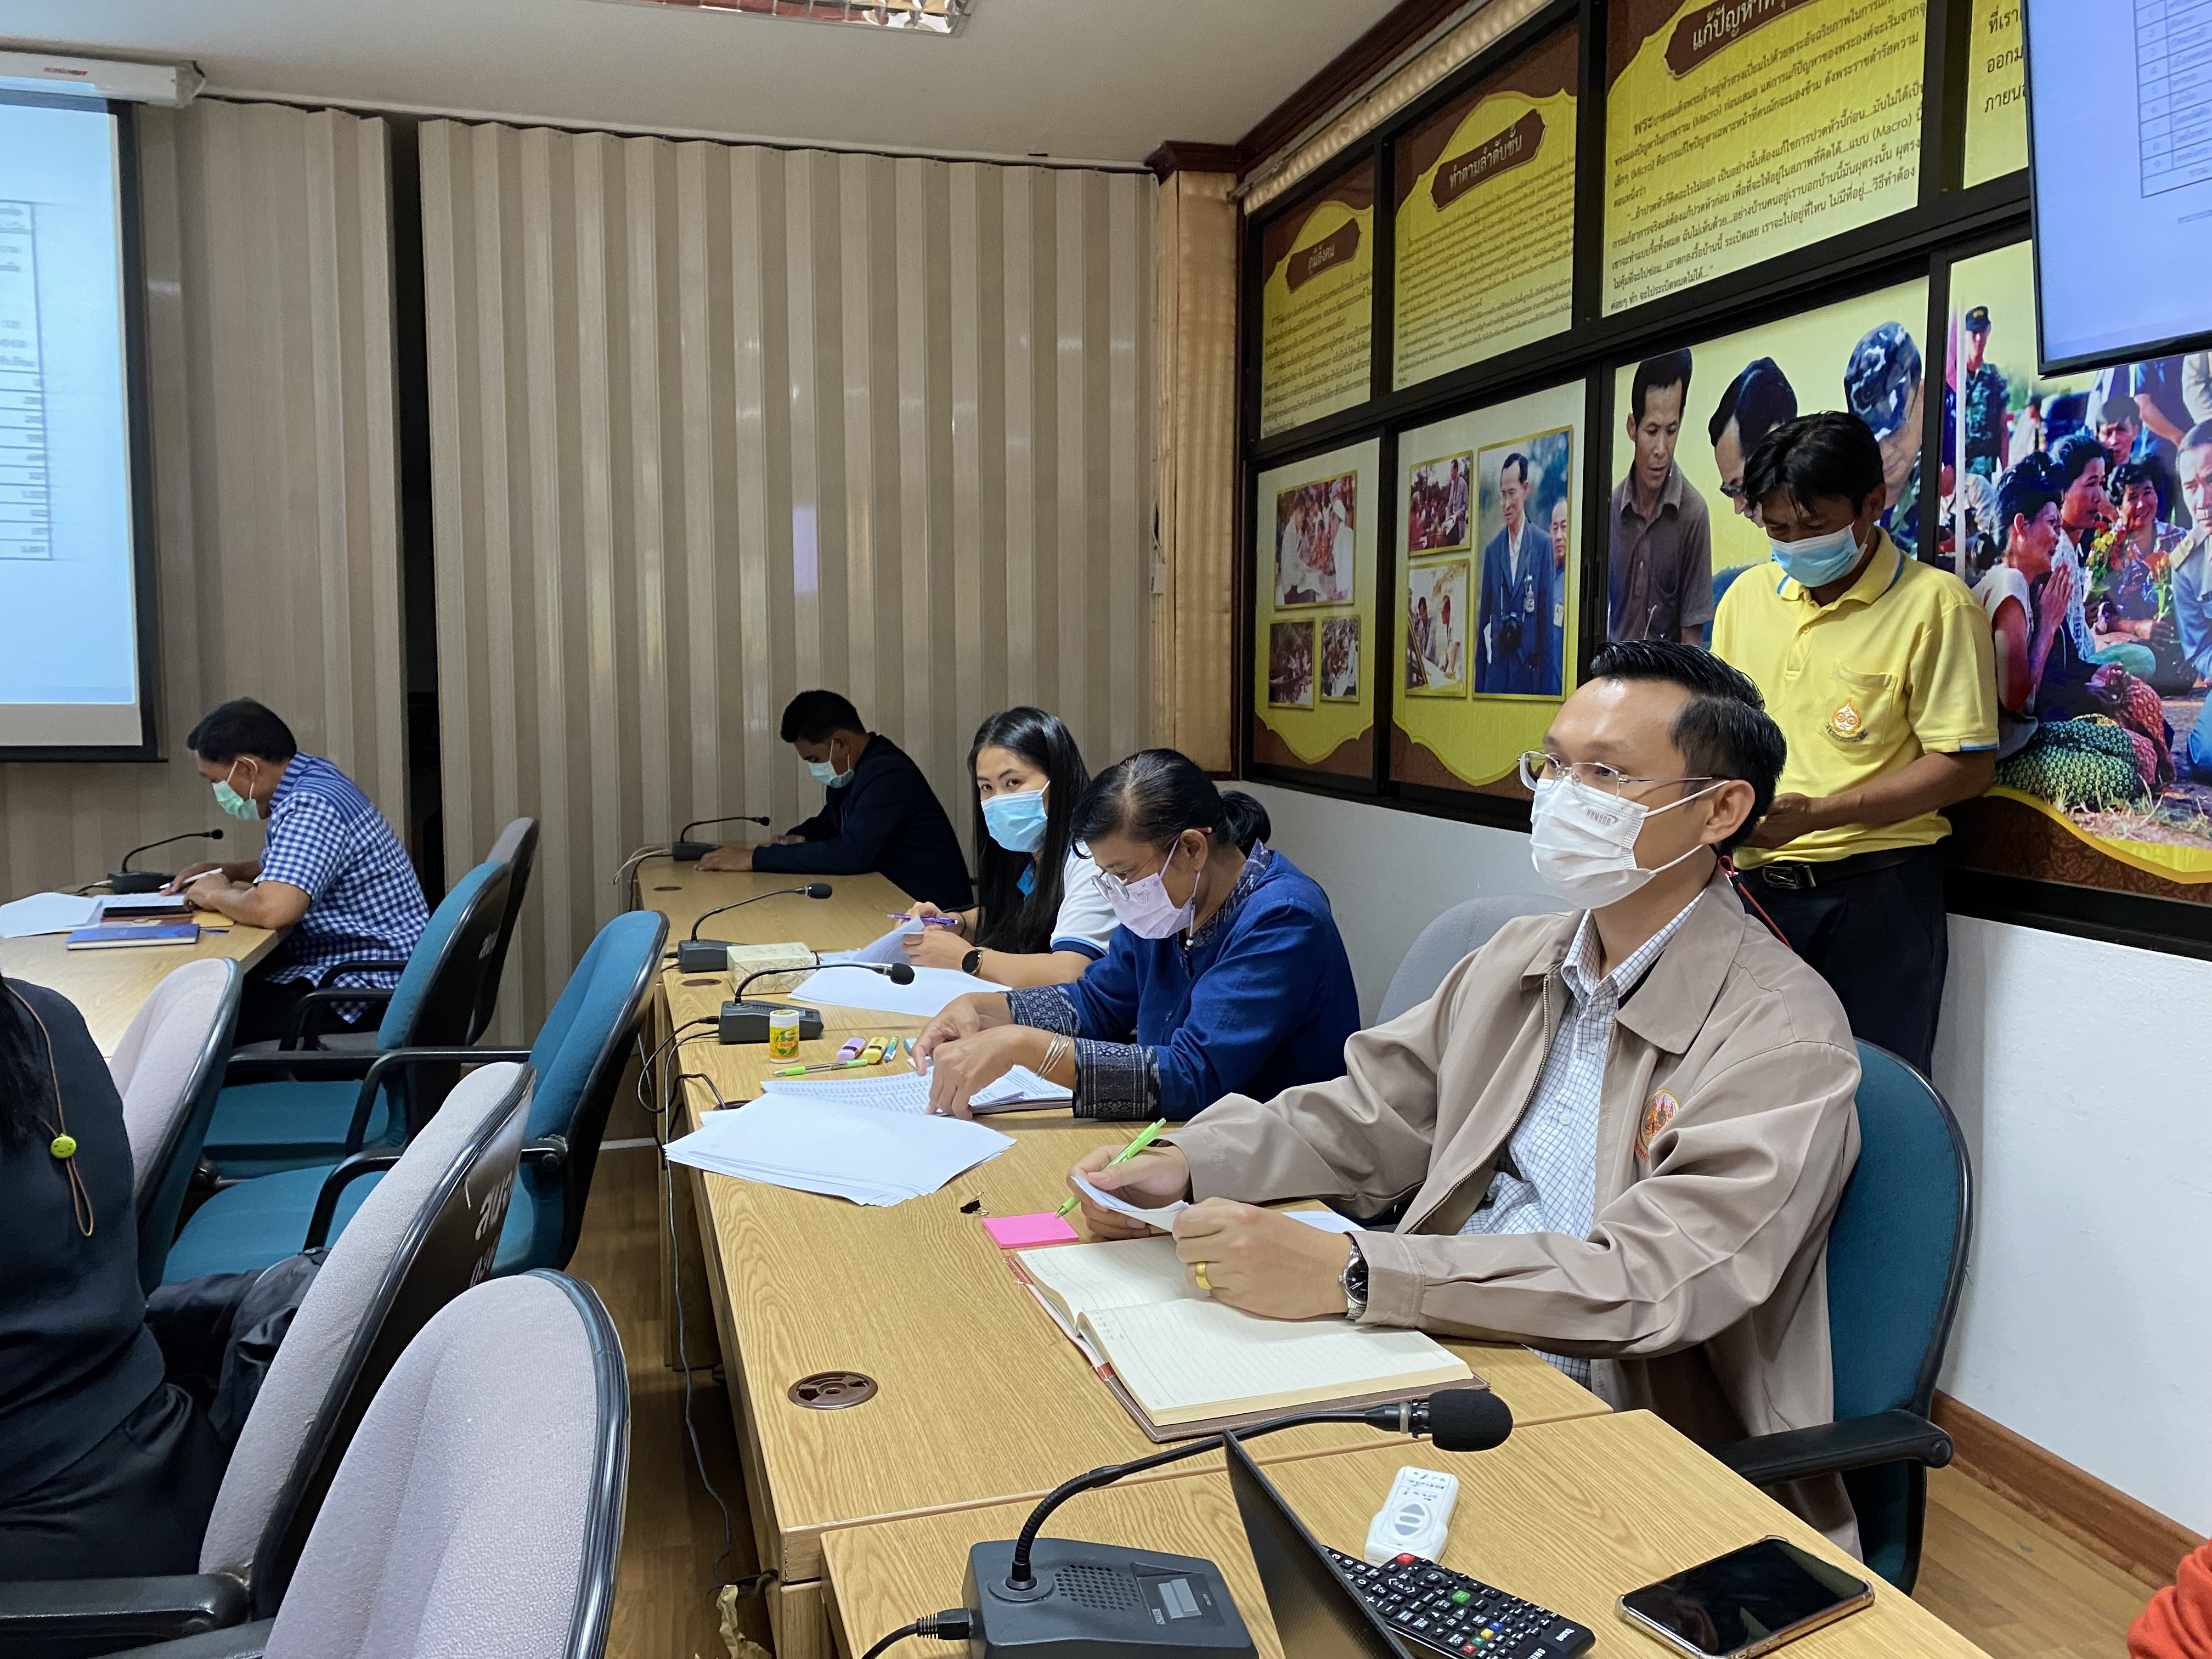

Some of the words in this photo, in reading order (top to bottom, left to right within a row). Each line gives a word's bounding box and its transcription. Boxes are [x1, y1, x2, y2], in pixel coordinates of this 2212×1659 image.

[1872, 113, 1912, 140] (Macro)
[1449, 123, 1522, 189] ทำตามลำดับขั้น
